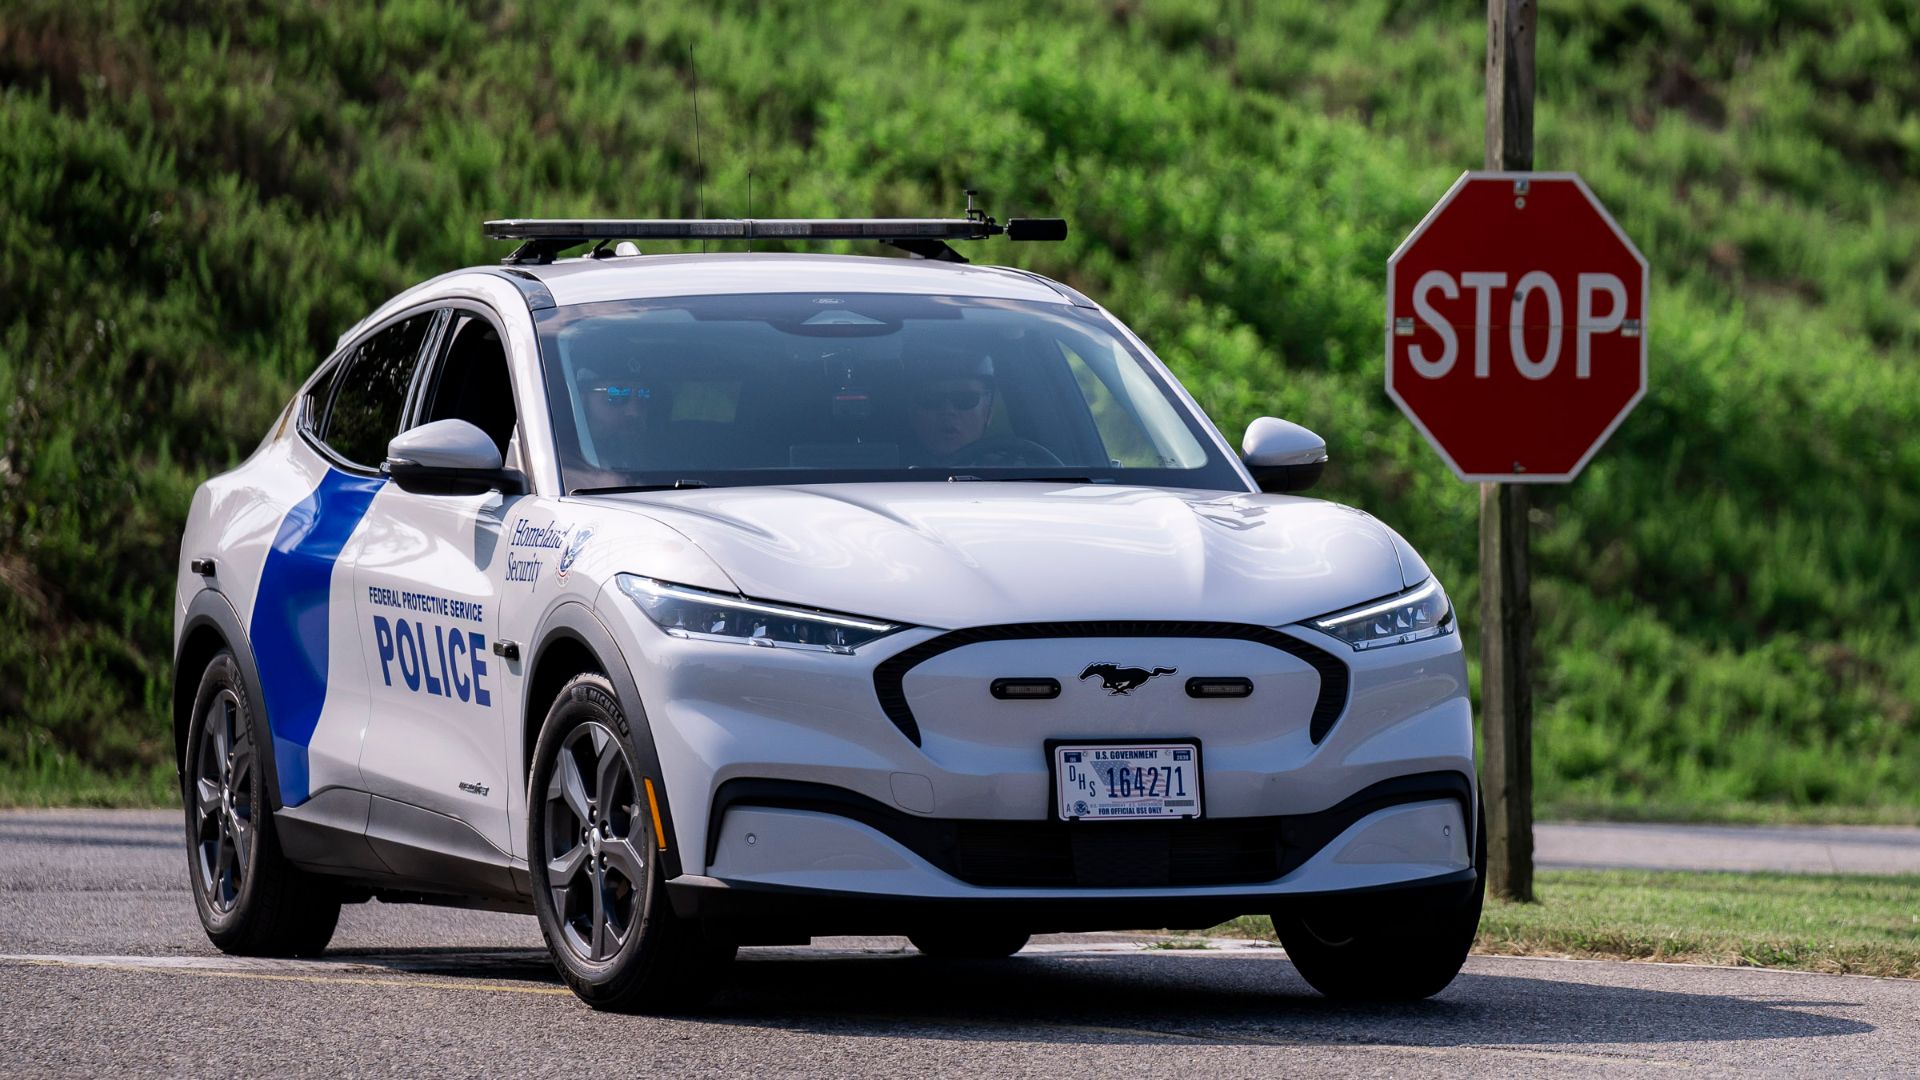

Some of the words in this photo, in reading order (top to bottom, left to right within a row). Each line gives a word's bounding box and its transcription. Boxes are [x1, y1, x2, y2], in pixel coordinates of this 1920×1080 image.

[1407, 270, 1628, 380] STOP
[511, 519, 575, 548] Homeland
[505, 552, 543, 593] Security
[369, 586, 401, 608] FEDERAL
[402, 591, 448, 616] PROTECTIVE
[450, 600, 482, 622] SERVICE
[373, 615, 491, 707] POLICE
[588, 689, 629, 736] MICHELIN
[1095, 751, 1109, 760] U.S.
[1110, 750, 1158, 760] GOVERNMENT
[1106, 766, 1186, 798] 164271
[1099, 807, 1110, 815] FOR
[1111, 807, 1135, 815] OFFICIAL
[1136, 807, 1148, 815] USE
[1149, 807, 1162, 815] ONLY
